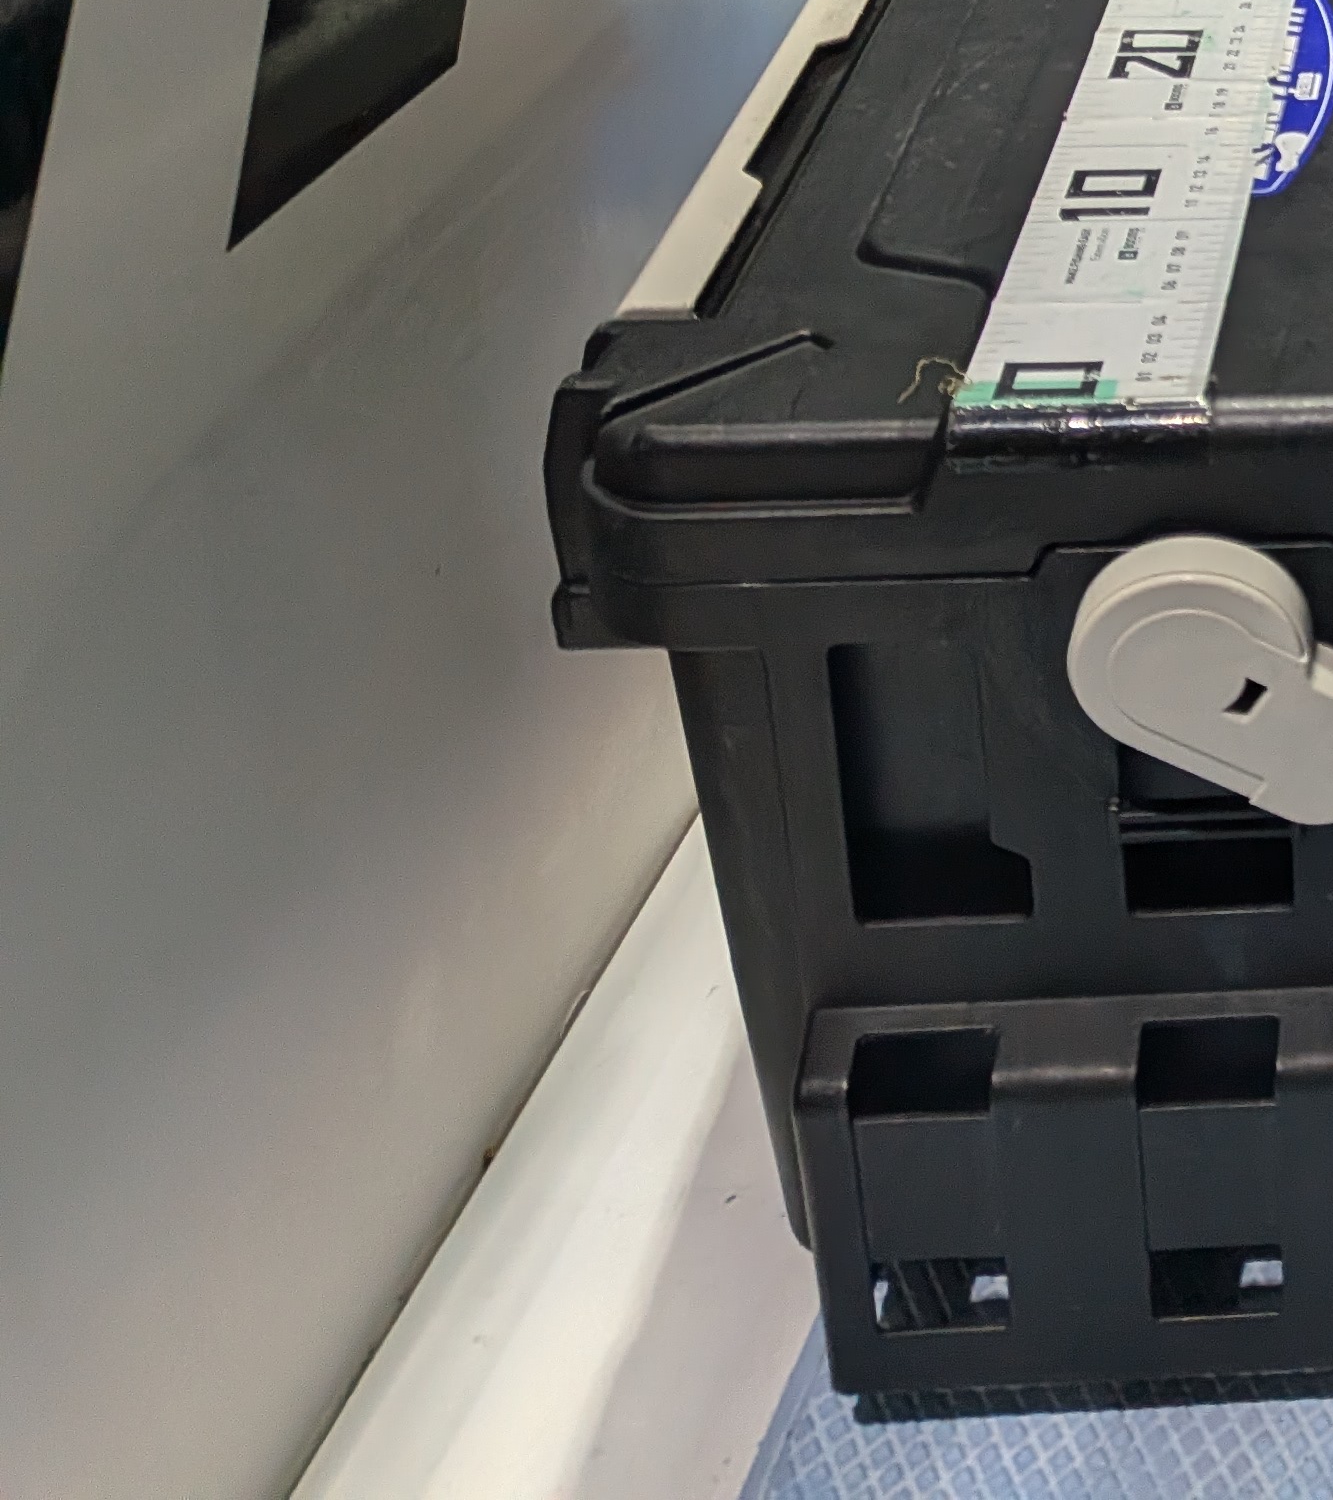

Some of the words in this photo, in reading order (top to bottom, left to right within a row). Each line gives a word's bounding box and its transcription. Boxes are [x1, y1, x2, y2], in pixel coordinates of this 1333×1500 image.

[1108, 30, 1203, 78] 20
[1059, 168, 1162, 220] 10
[993, 362, 1103, 398] 0
